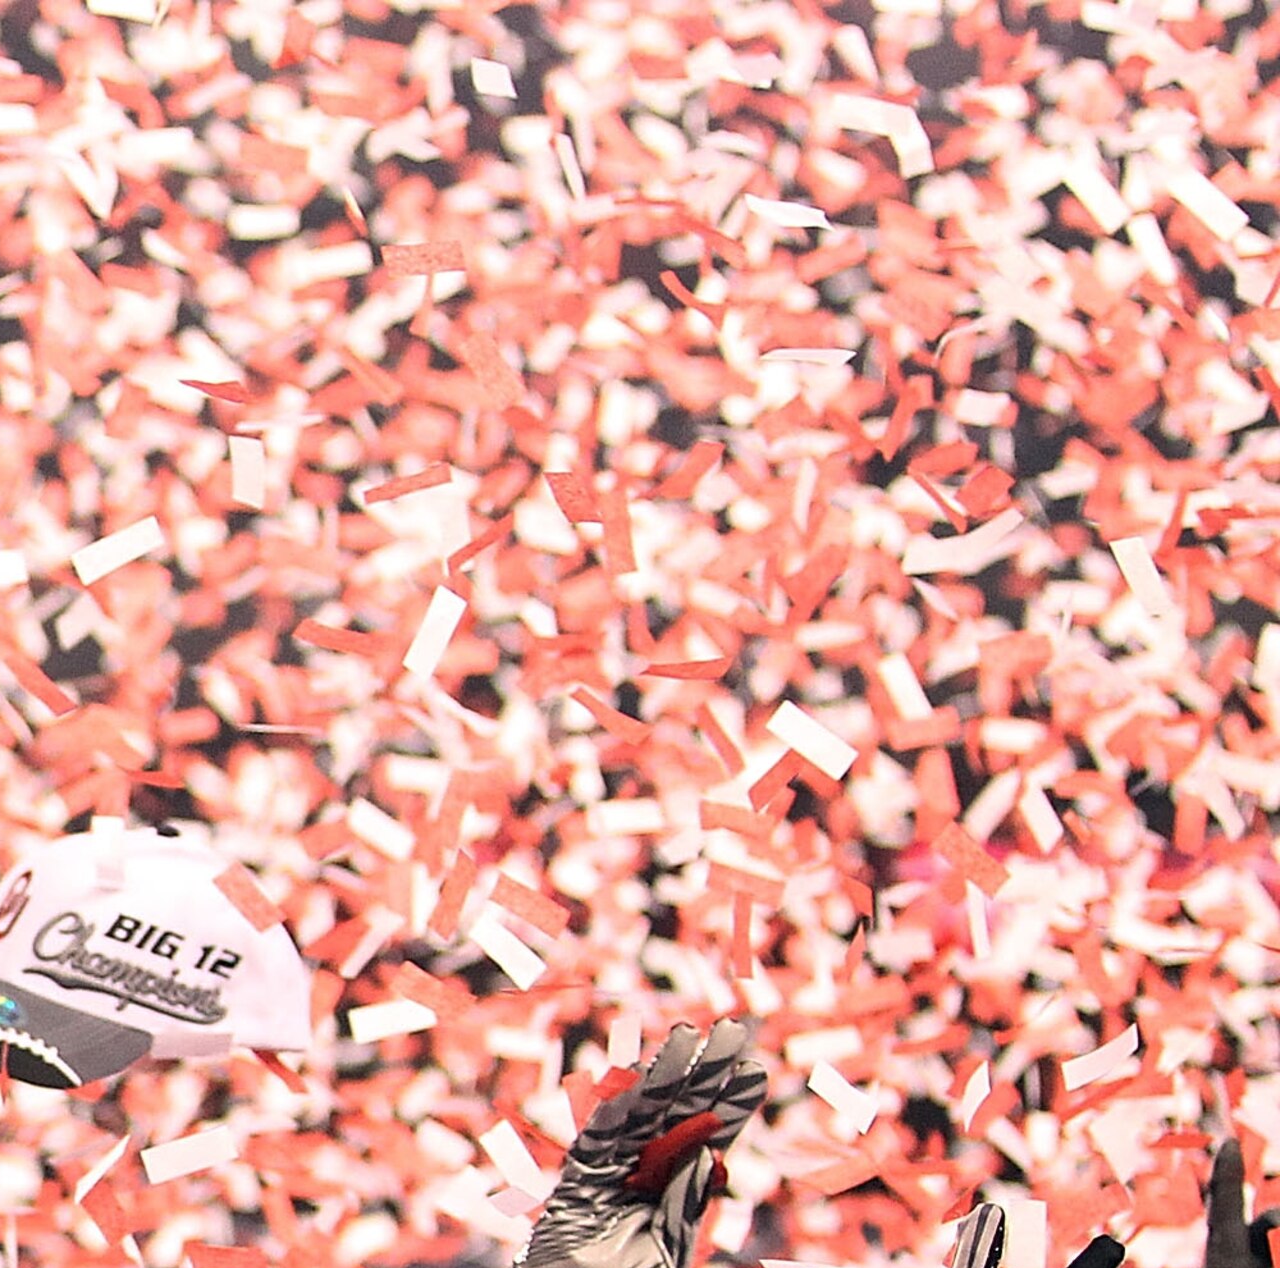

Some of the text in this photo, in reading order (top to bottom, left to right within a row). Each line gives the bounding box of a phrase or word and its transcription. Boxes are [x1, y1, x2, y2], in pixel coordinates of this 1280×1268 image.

[22, 910, 230, 1026] Champions
[104, 913, 244, 979] BIG 12
